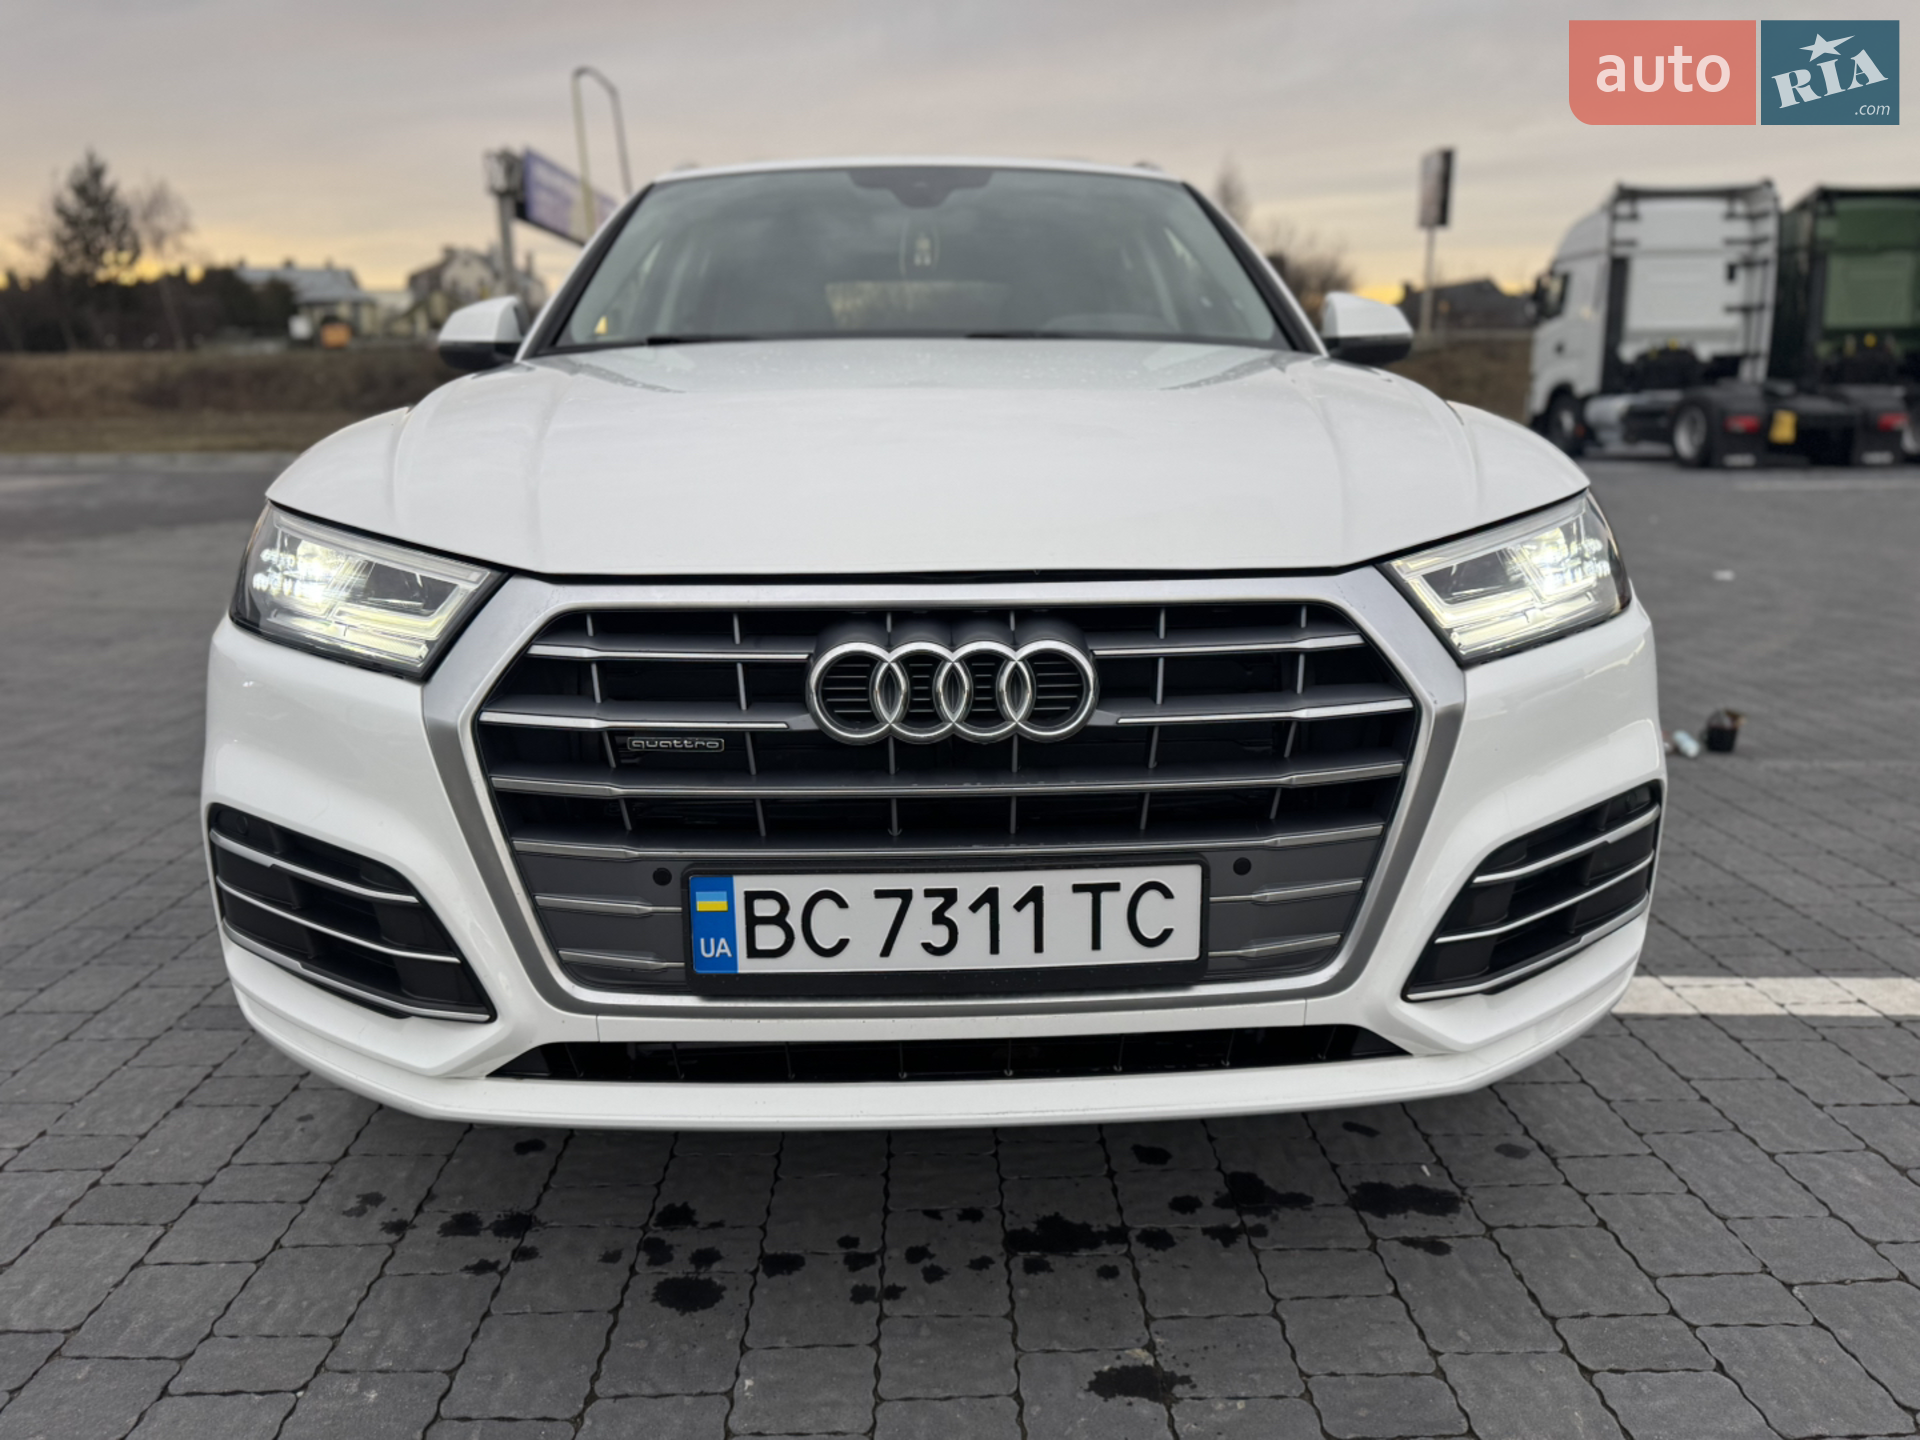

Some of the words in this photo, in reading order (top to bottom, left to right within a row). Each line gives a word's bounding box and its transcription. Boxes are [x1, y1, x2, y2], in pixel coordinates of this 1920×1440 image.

[631, 739, 720, 750] quattro
[743, 888, 851, 959] BC
[873, 885, 1045, 957] 7311
[1071, 880, 1176, 951] TC
[700, 937, 732, 958] UA
